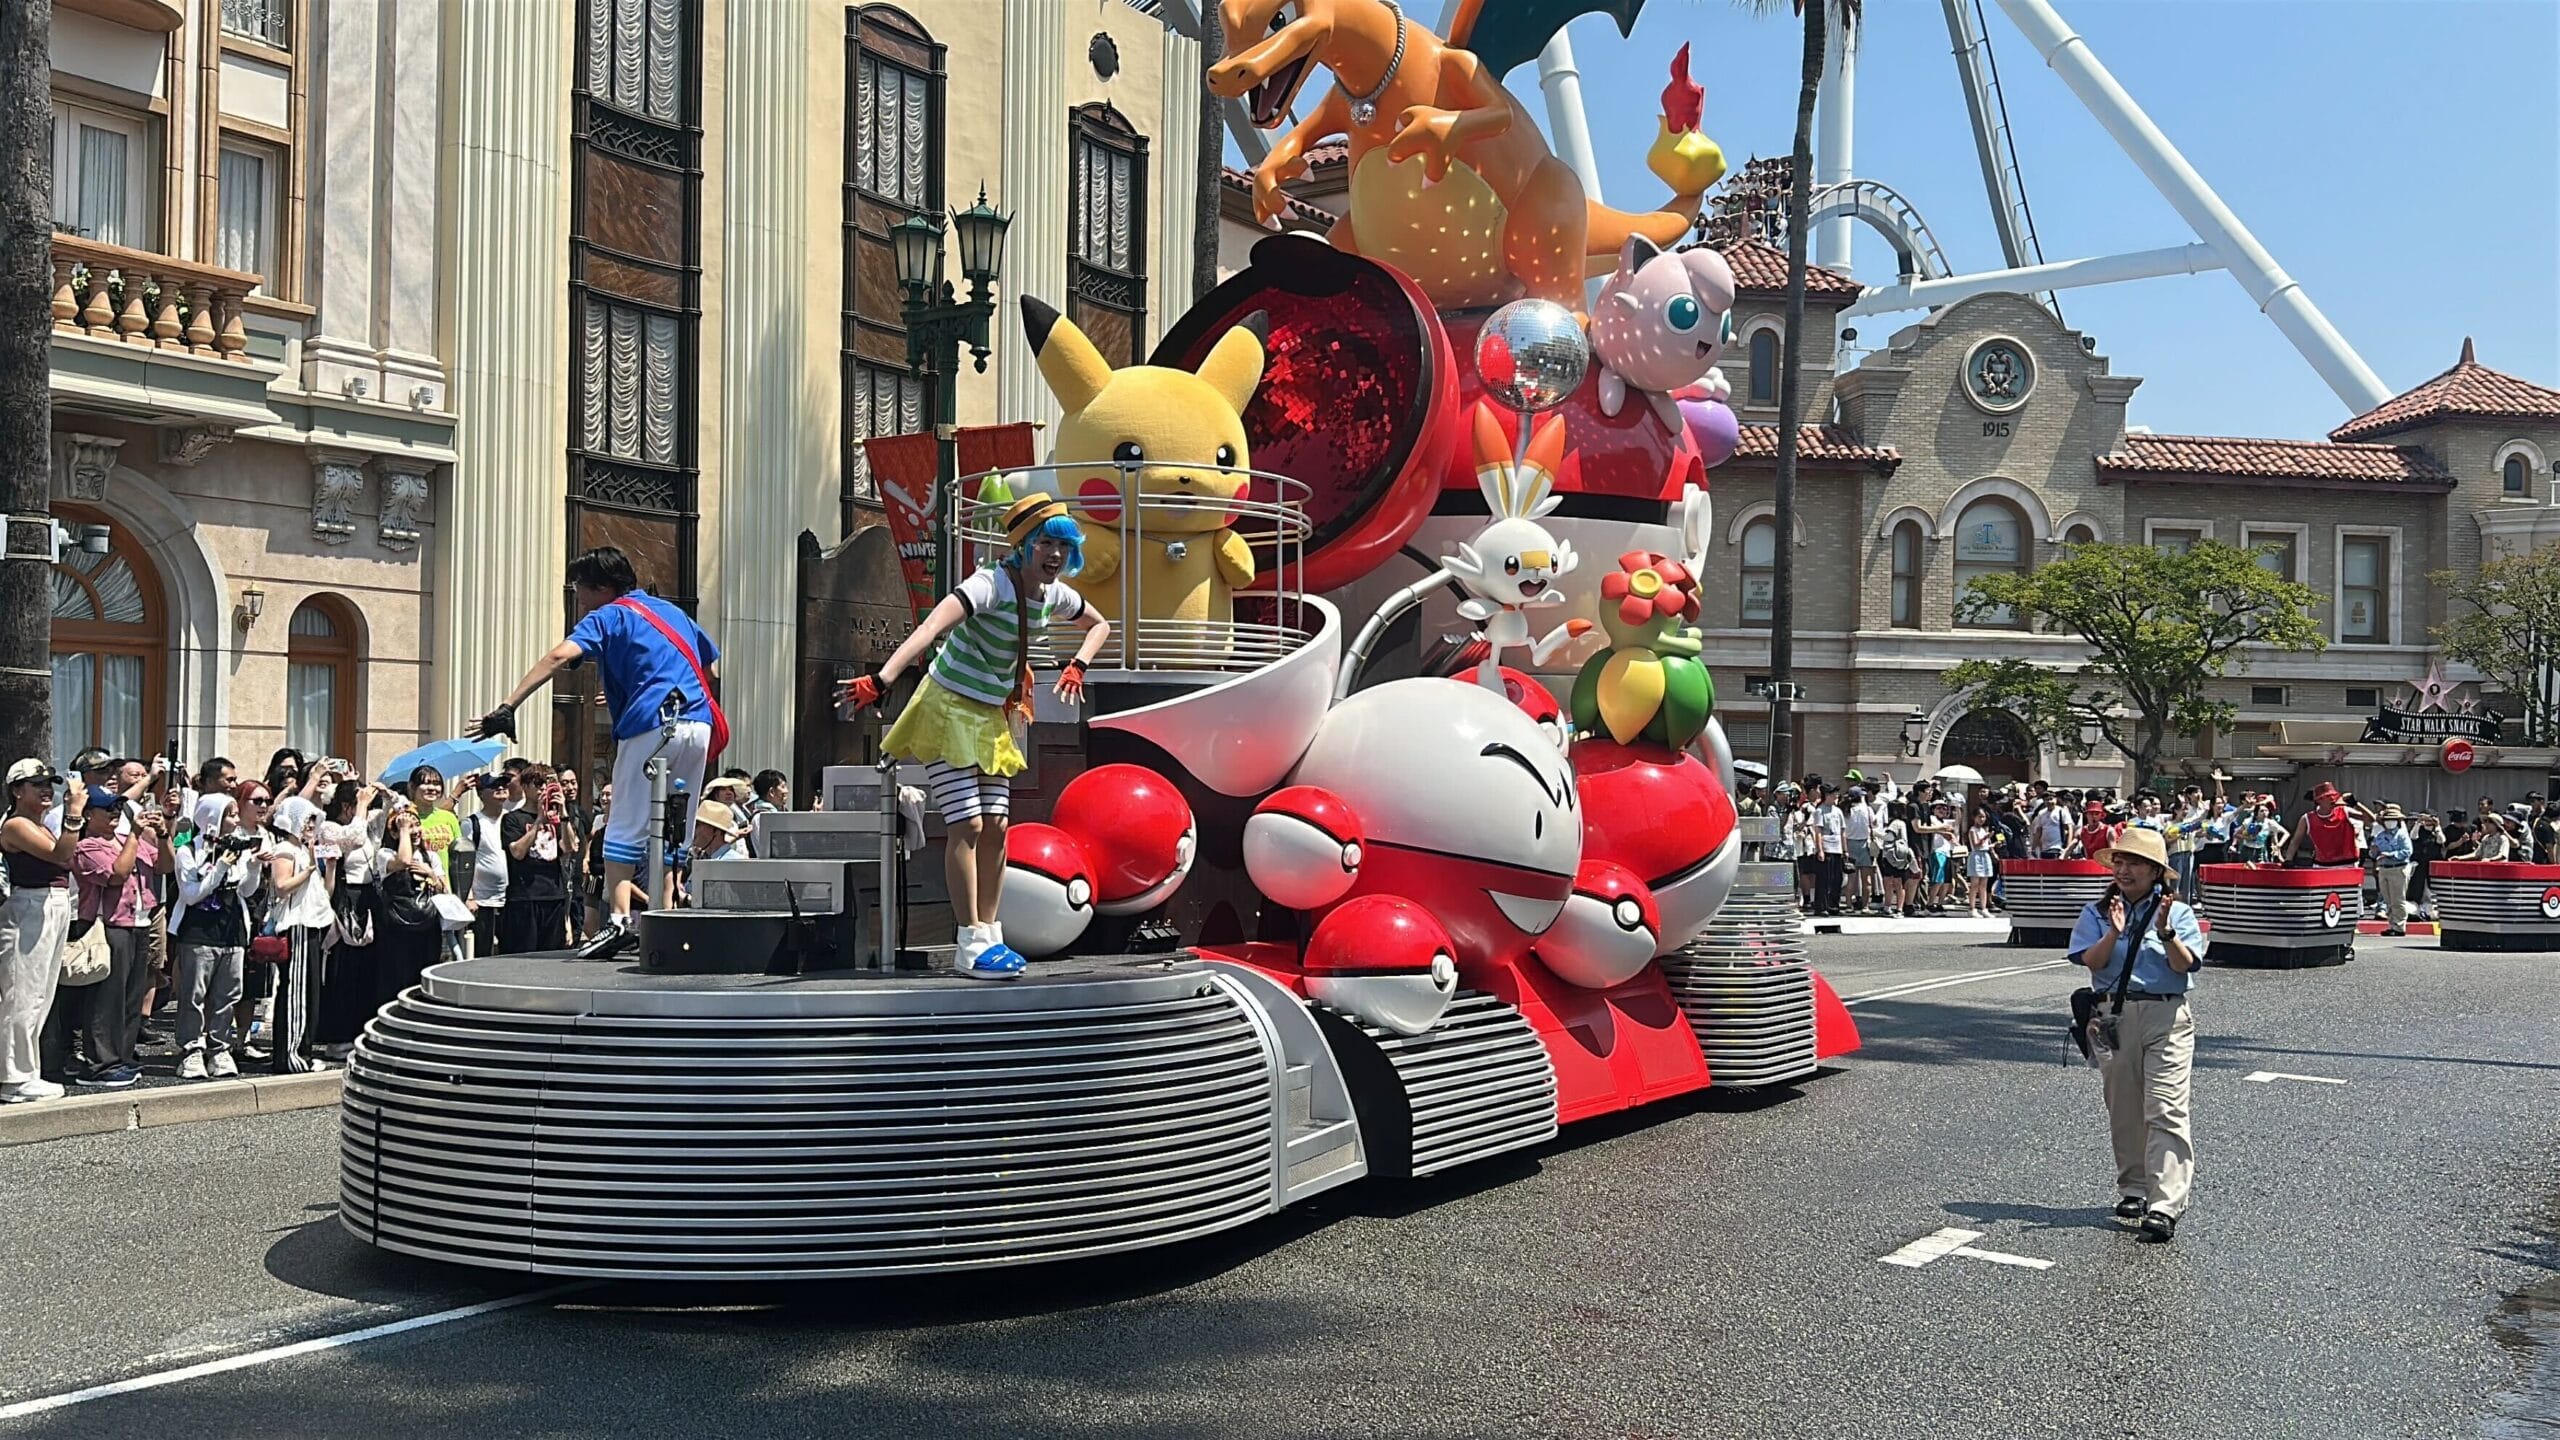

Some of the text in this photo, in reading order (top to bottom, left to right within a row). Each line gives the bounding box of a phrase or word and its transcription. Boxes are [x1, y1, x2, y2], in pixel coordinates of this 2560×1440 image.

[1983, 421, 2010, 437] 1915
[899, 542, 936, 558] NINTE
[850, 617, 891, 636] MAX
[1928, 698, 1969, 748] HOLLYWO
[2400, 716, 2481, 735] STAR WALK SNACKS
